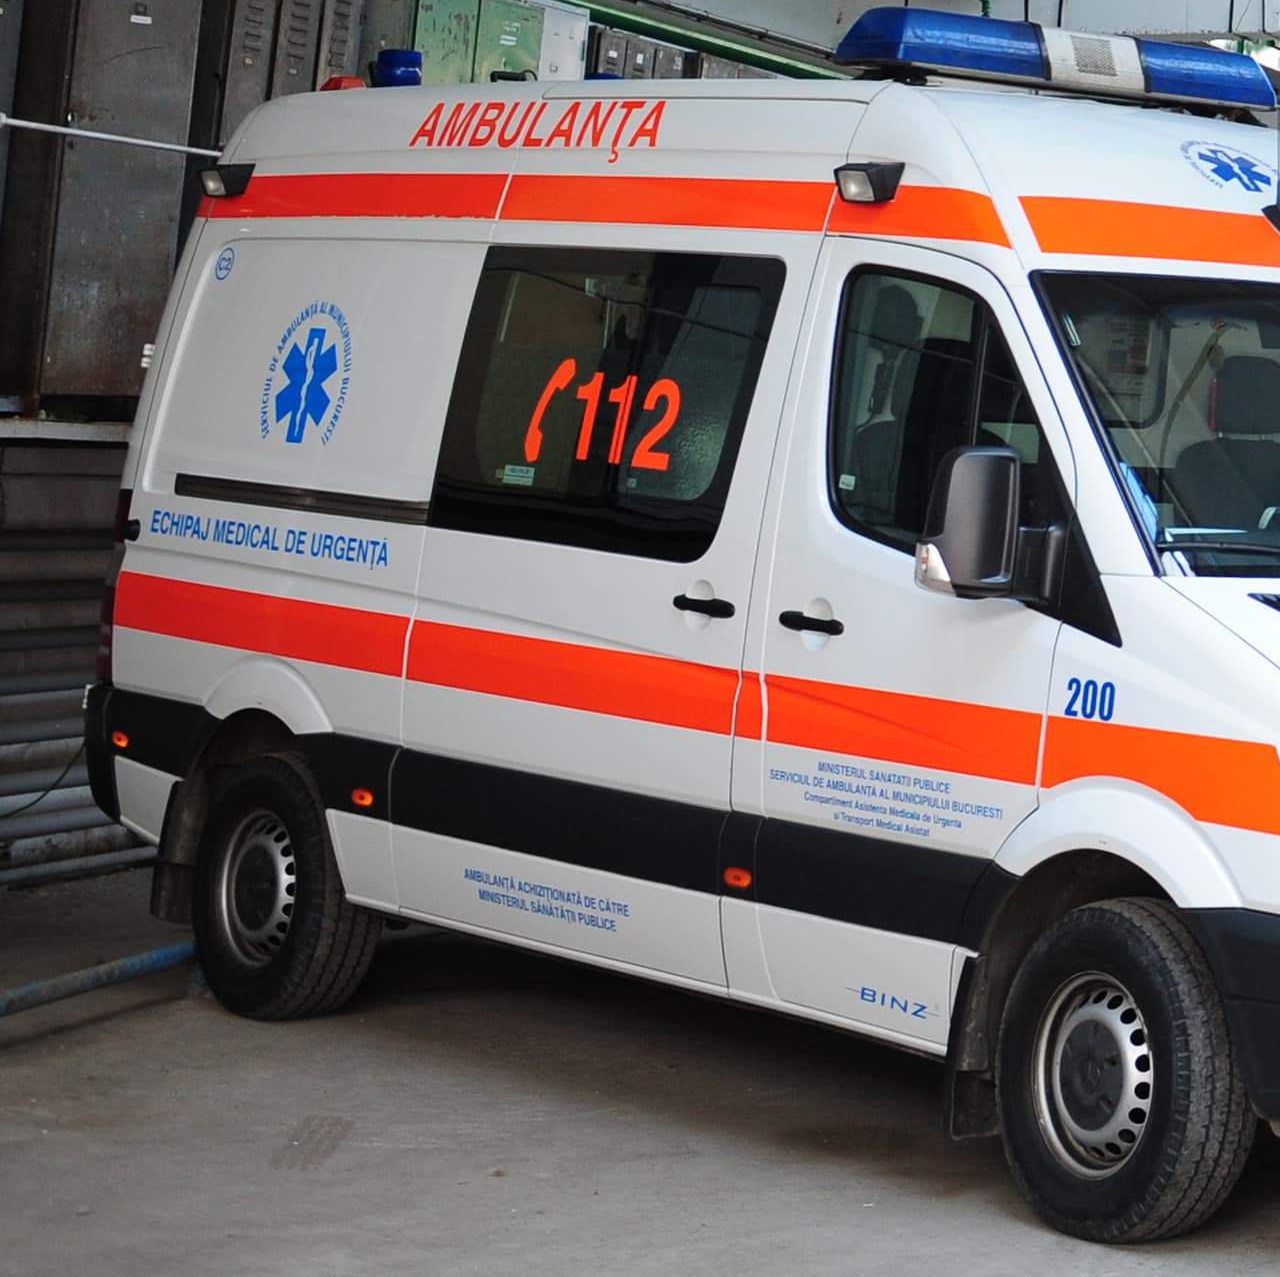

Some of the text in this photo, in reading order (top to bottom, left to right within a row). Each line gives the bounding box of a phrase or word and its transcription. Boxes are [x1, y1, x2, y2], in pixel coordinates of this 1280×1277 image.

[575, 370, 682, 472] 112
[150, 509, 211, 541] ECHIPAJ
[213, 519, 279, 552] MEDICAL
[284, 529, 308, 555] DE
[1064, 677, 1115, 721] 200
[769, 769, 810, 786] SERVICIUL
[813, 776, 825, 788] DE
[879, 787, 890, 800] AL
[892, 790, 950, 810] MUNICIPIULUI
[951, 801, 1004, 820] BUCURESTI
[818, 761, 867, 780] MINISTERUL
[913, 777, 951, 794] PUBLICE
[804, 791, 853, 808] Compartiment
[922, 813, 931, 823] de
[841, 811, 874, 827] Transport
[876, 817, 903, 832] Medical
[478, 888, 529, 912] MINISTERUL
[578, 912, 617, 932] PUBLICE
[584, 895, 597, 910] DE
[860, 986, 928, 1019] BINZ
